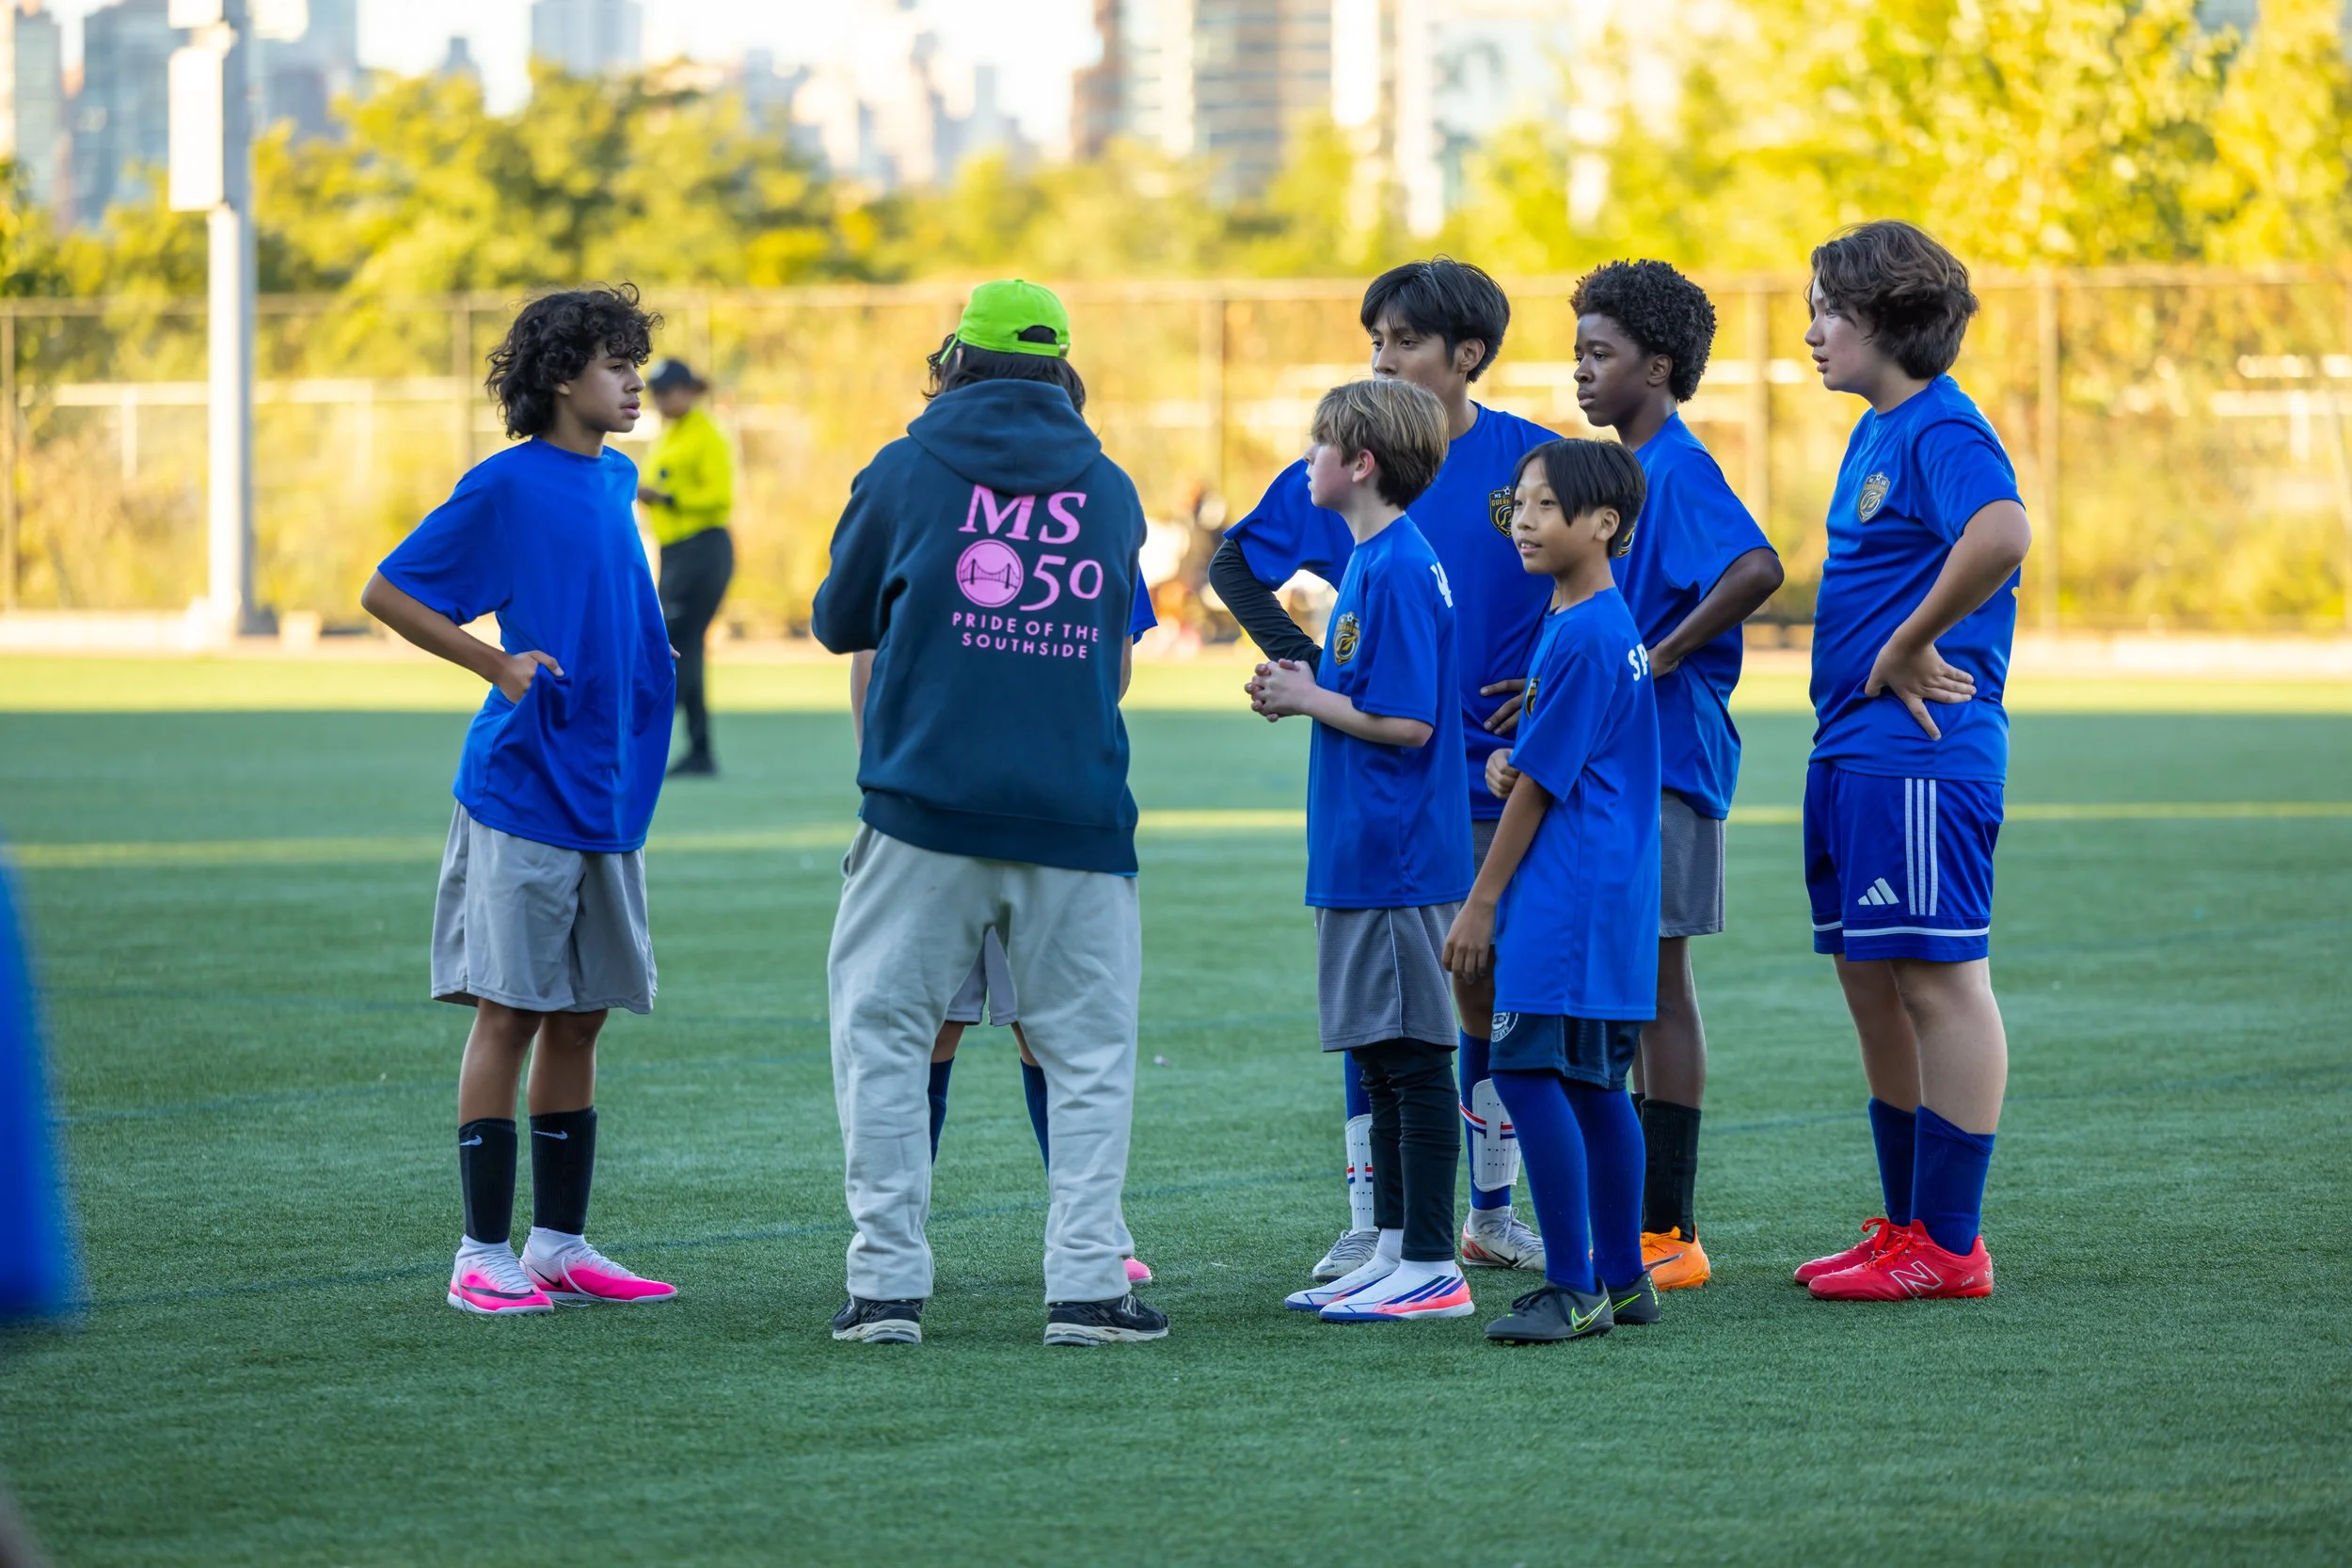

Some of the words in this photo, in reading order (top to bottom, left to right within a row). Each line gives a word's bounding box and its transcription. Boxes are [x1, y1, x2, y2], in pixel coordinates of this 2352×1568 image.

[958, 483, 1088, 545] MS
[1019, 554, 1104, 611] 50
[952, 612, 1018, 633] PRIDE
[1025, 621, 1055, 637] OF
[1063, 624, 1099, 642] THE
[961, 632, 1089, 658] SOUTHSIDE
